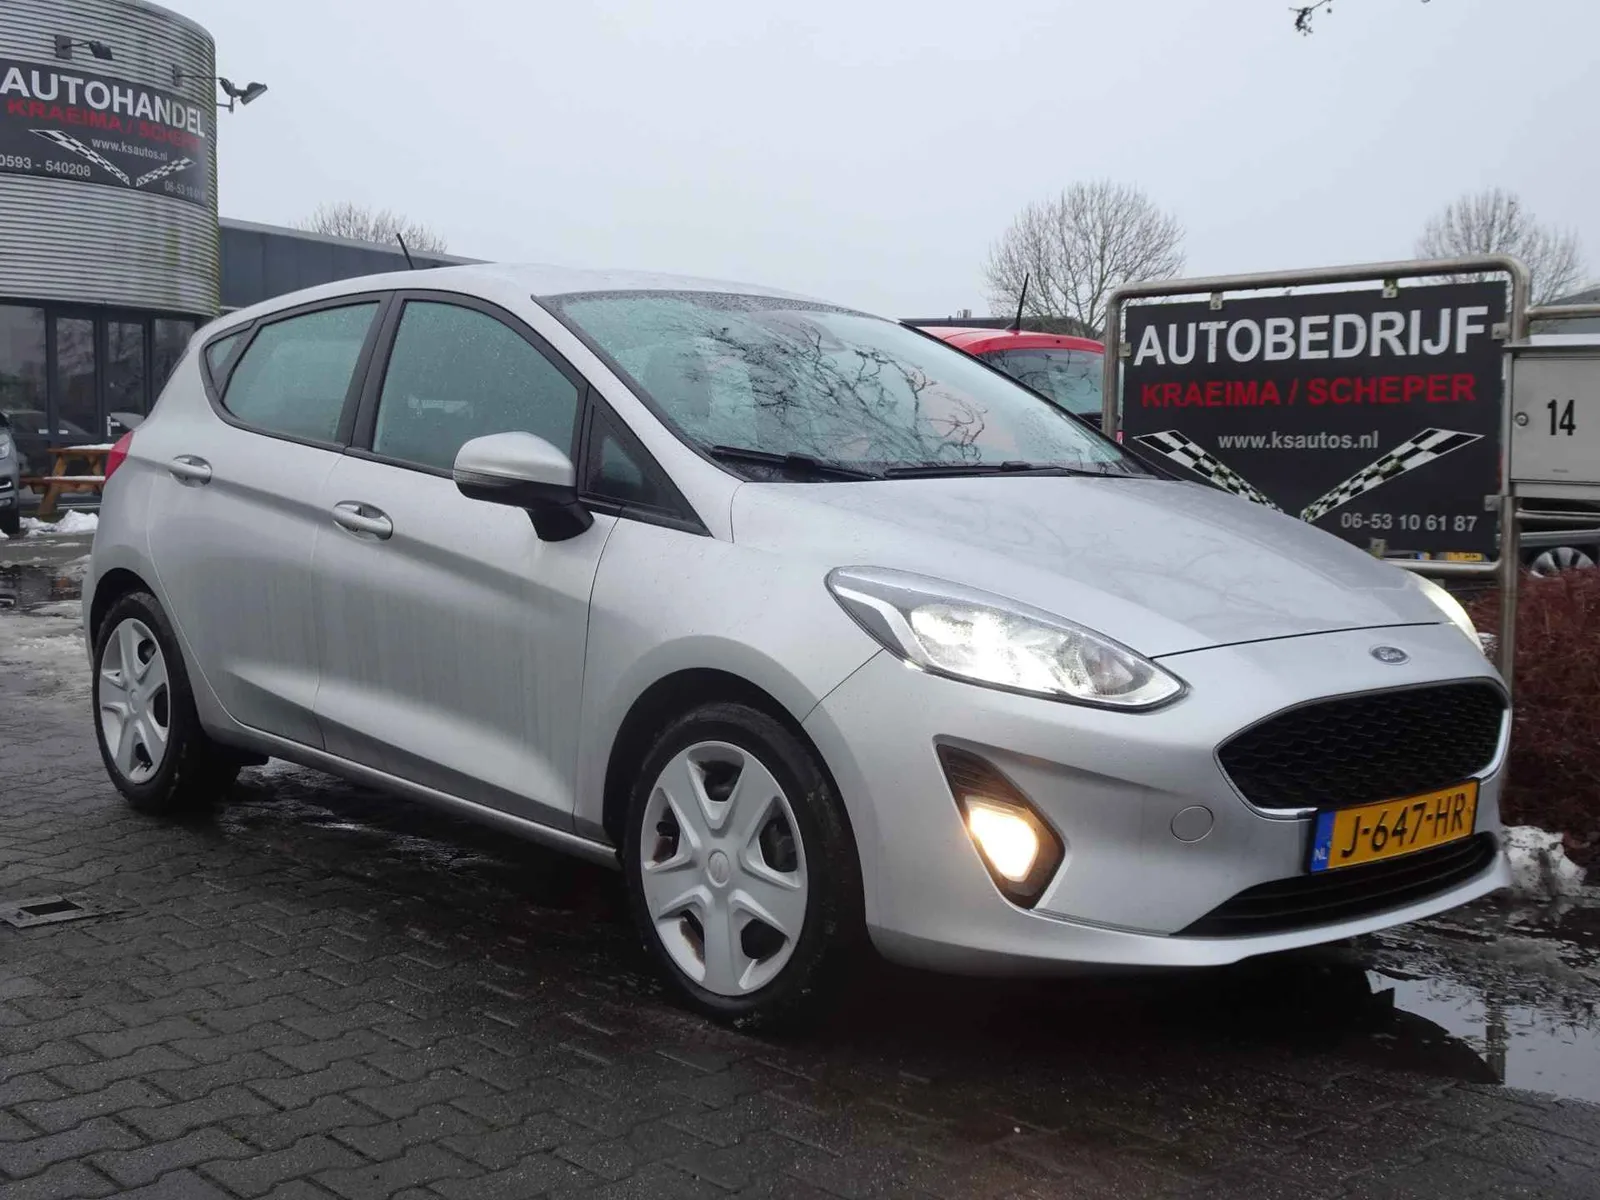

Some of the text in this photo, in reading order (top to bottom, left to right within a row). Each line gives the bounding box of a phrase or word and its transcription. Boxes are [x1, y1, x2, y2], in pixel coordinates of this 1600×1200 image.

[0, 66, 205, 137] AUTOHANDEL
[7, 97, 122, 132] KRAEIMA
[0, 153, 32, 169] 0593
[45, 160, 91, 177] 540208
[91, 138, 167, 161] www.ksautos.nl
[1133, 305, 1488, 366] AUTOBEDRIJF
[1141, 373, 1477, 408] KRAEIMA / SCHEPER
[1547, 399, 1576, 436] 14
[1218, 430, 1379, 449] www.ksautos.nl
[1341, 512, 1477, 532] 06-53 10 61 87
[1340, 793, 1466, 858] J-647-HR
[1314, 847, 1328, 861] NL
